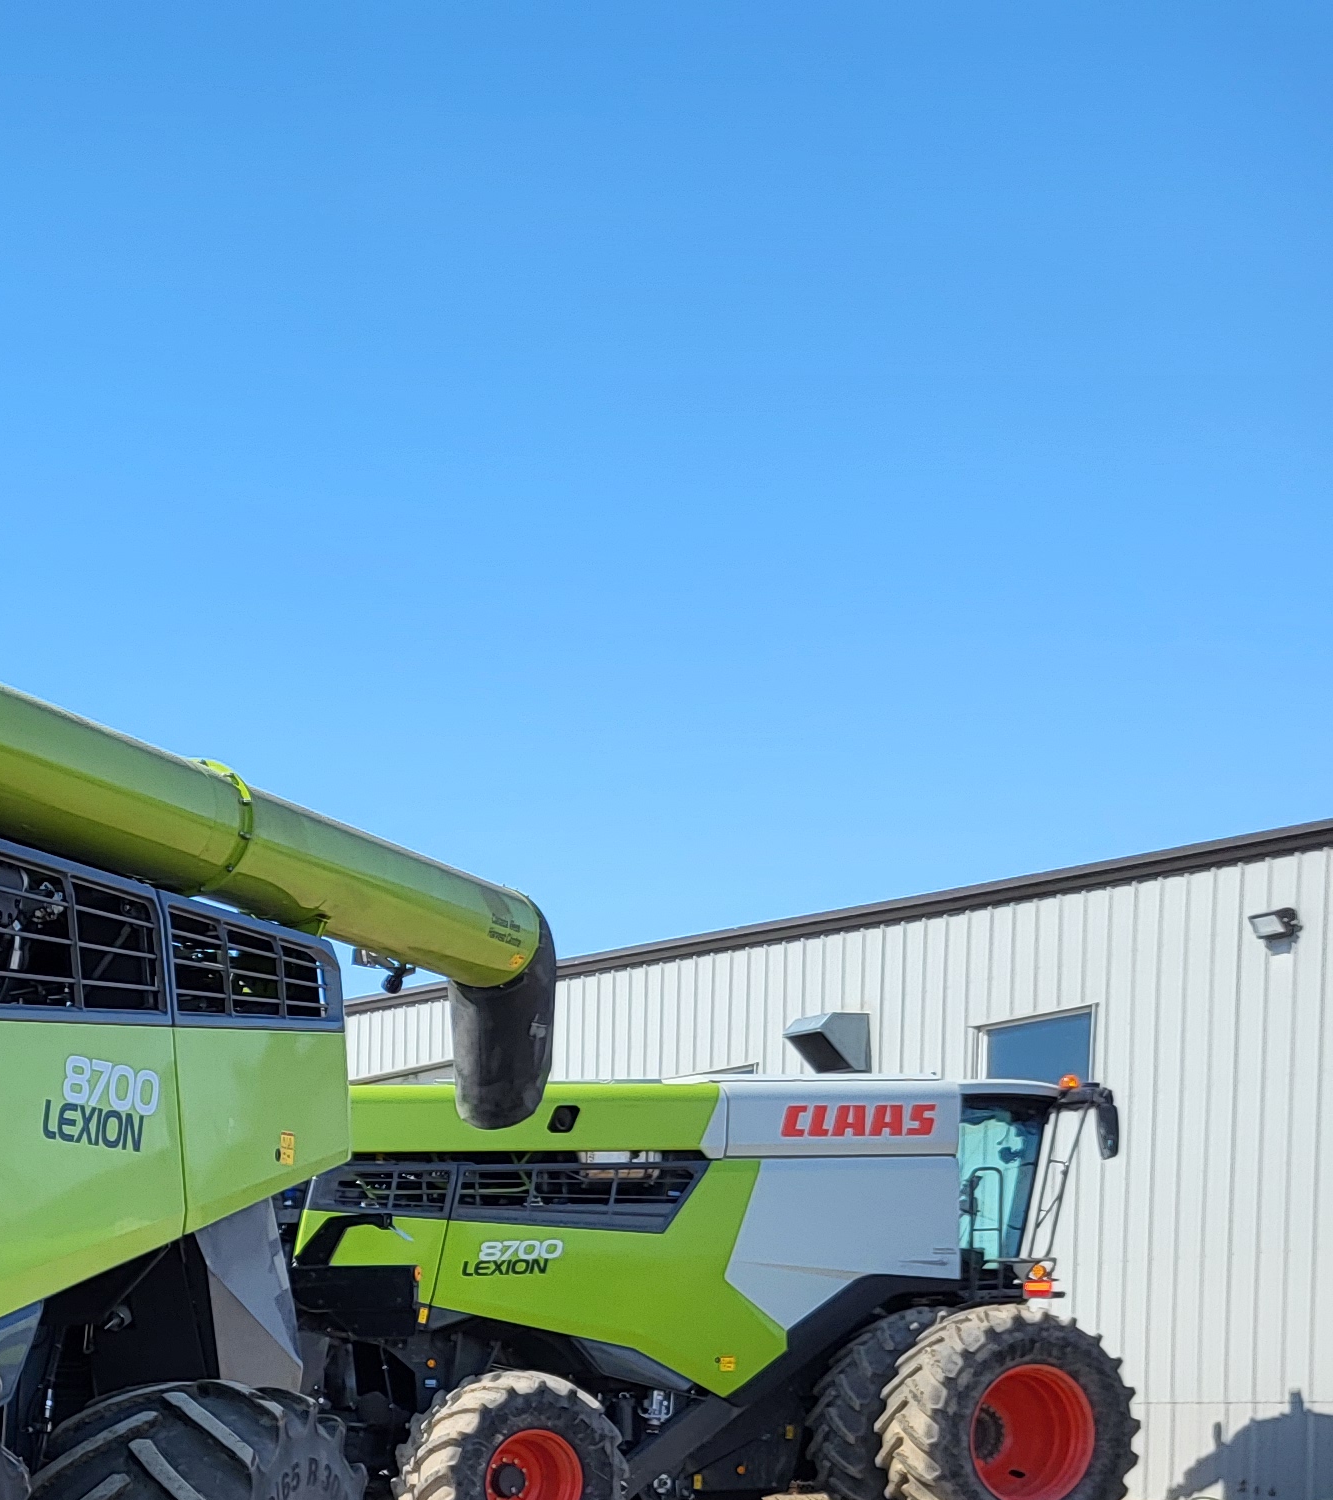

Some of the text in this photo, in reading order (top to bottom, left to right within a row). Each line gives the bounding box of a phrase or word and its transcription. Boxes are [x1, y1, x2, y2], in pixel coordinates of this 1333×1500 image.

[63, 1055, 160, 1116] 8700
[42, 1098, 145, 1153] LEXION
[781, 1104, 937, 1137] CLAAS
[479, 1239, 564, 1261] 8700
[461, 1258, 549, 1277] LEXION
[307, 1457, 319, 1487] R
